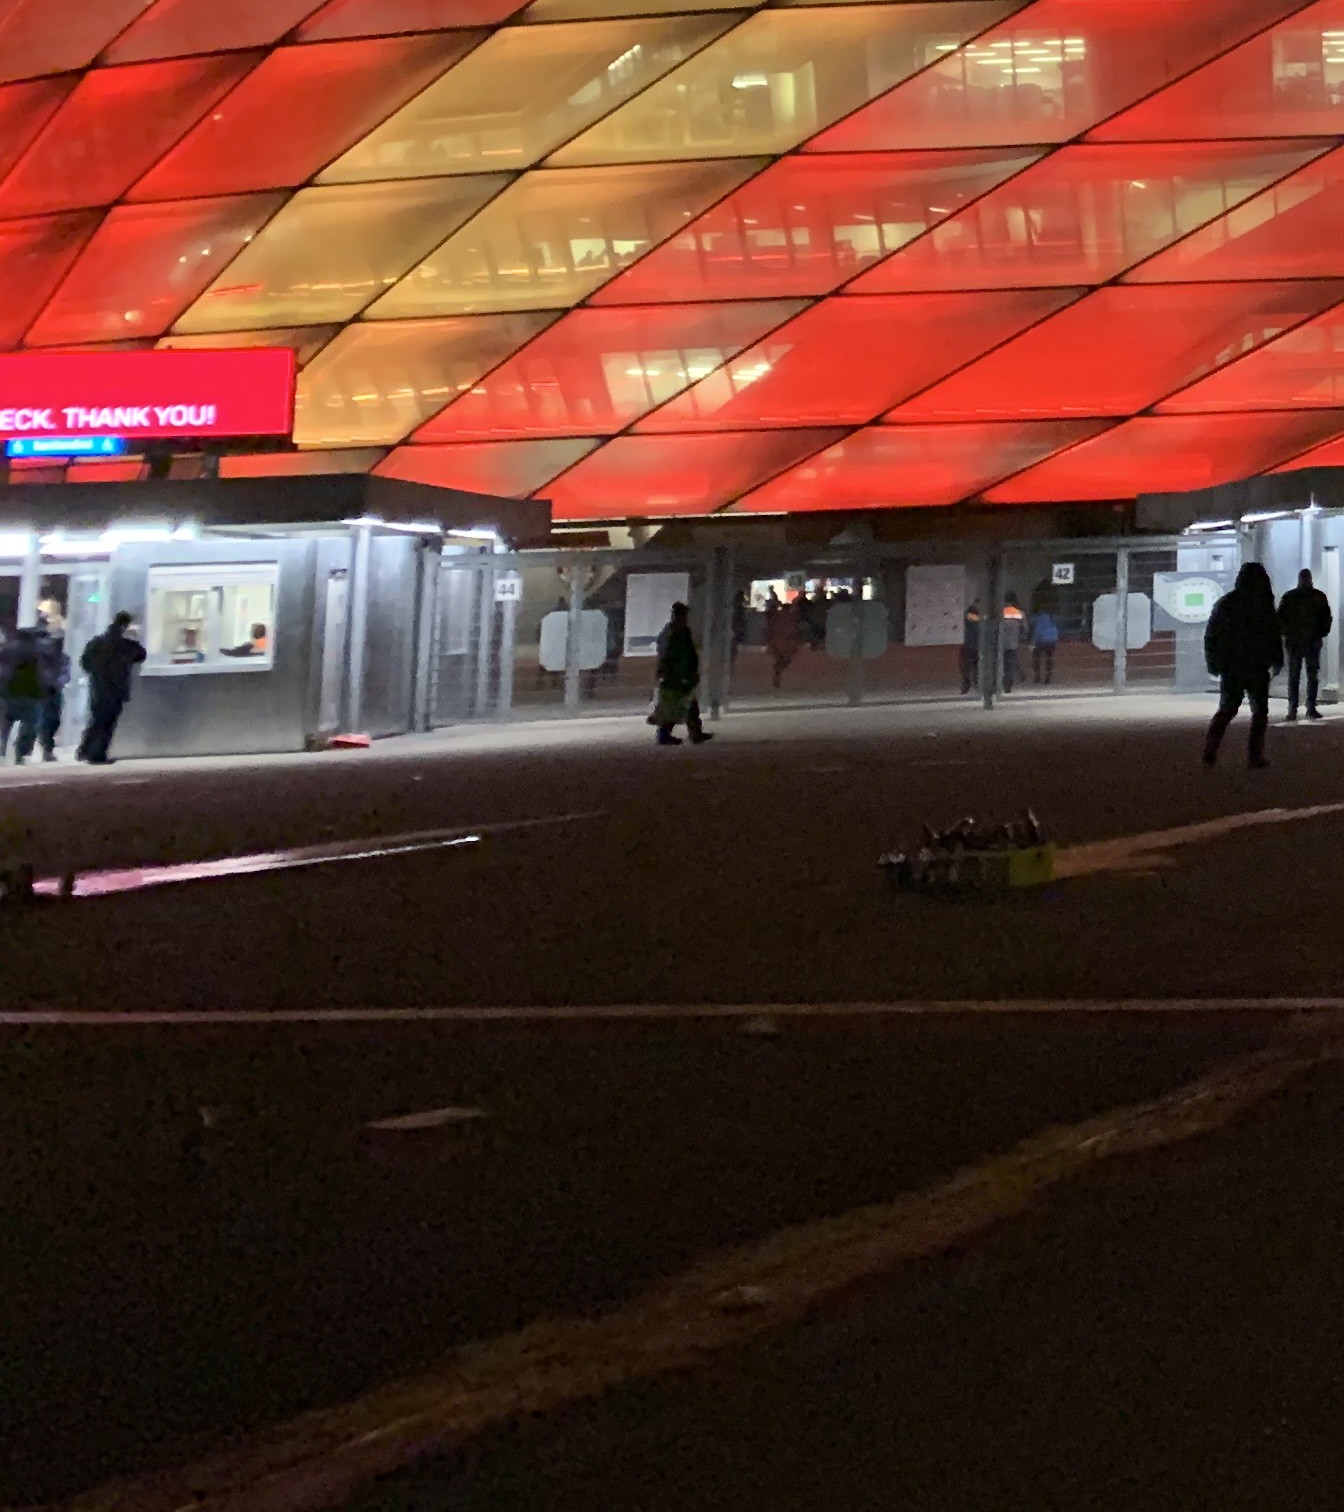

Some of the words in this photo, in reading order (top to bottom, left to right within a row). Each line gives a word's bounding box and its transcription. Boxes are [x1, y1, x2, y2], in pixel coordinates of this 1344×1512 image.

[61, 405, 150, 429] THANK
[153, 404, 216, 427] YOU!
[1055, 567, 1071, 580] 42
[498, 583, 515, 595] 44
